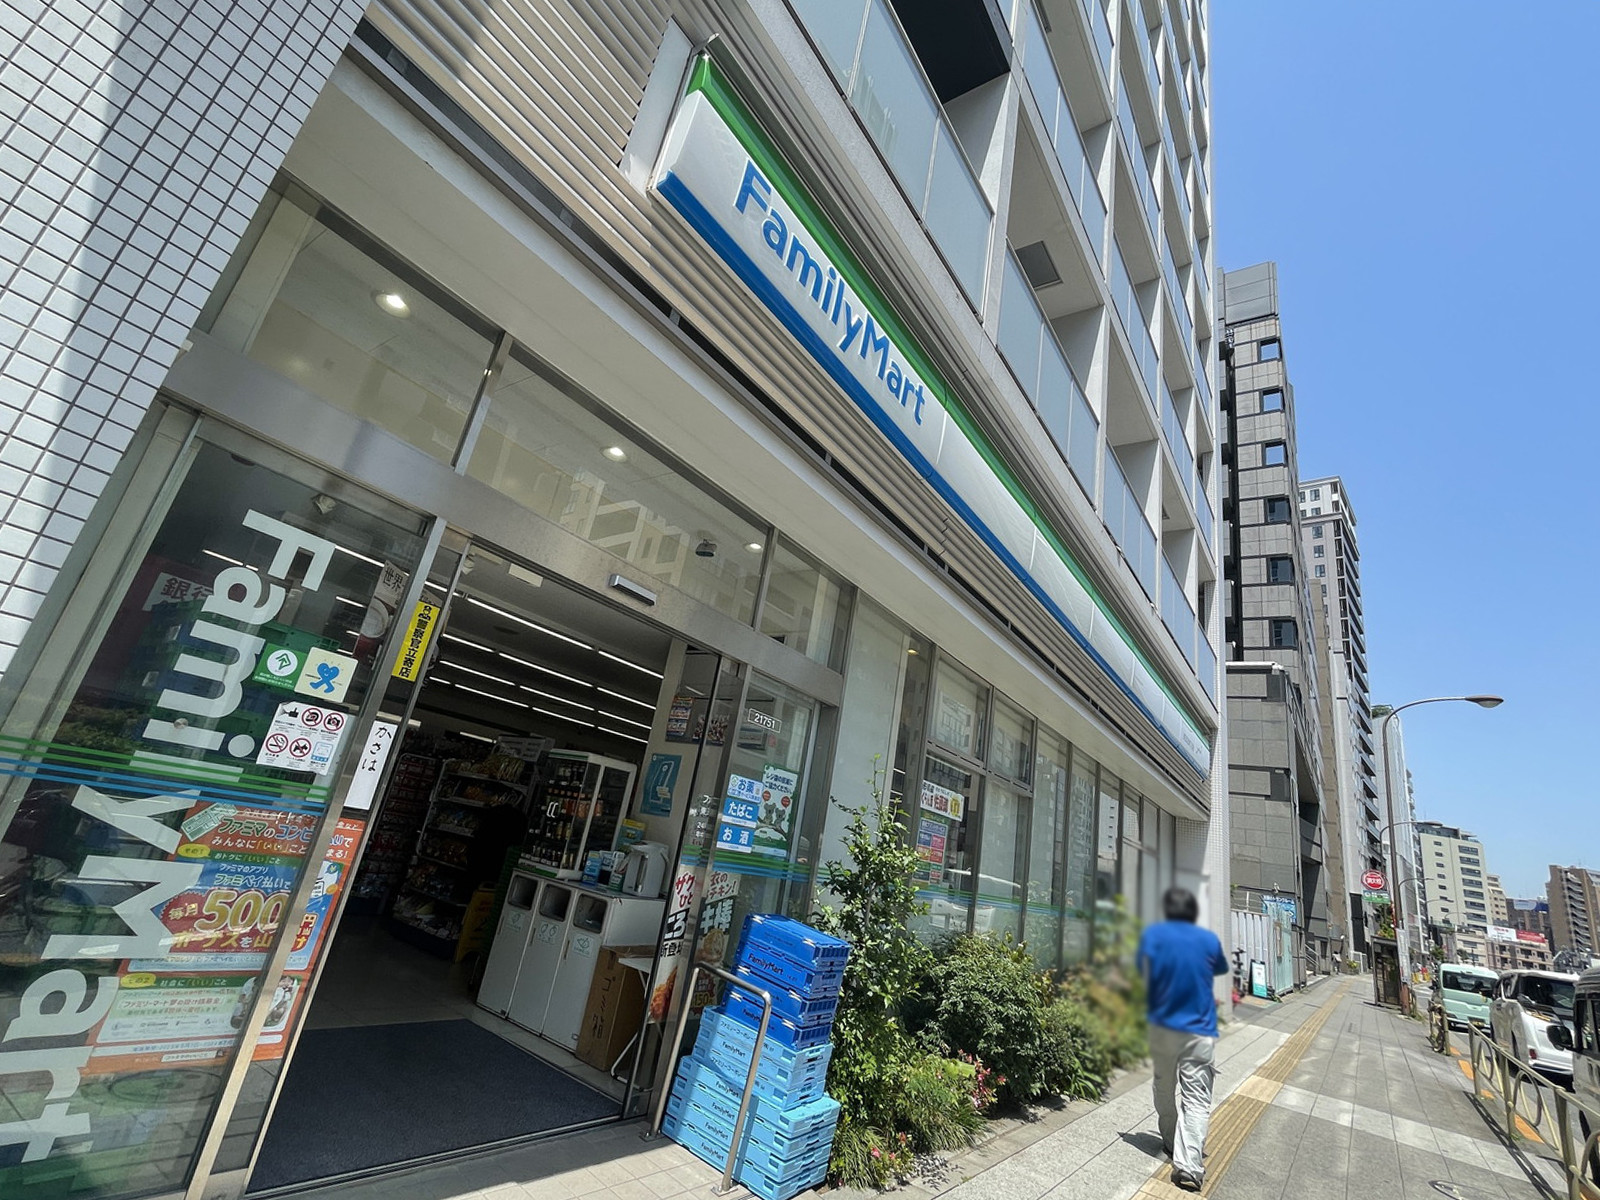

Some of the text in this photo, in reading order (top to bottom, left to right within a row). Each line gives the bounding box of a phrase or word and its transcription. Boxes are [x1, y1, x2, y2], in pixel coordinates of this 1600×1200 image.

[734, 159, 927, 427] FamilyMart
[399, 618, 429, 678] 警察官立寄店
[754, 713, 776, 728] 21751
[362, 727, 392, 772] かさは
[728, 801, 753, 819] たばこ
[0, 509, 336, 1164] FamilyMart
[723, 827, 750, 845] お酒
[748, 954, 784, 975] FamilyMart
[721, 1041, 746, 1058] FamilyMart
[716, 1081, 739, 1098] FamilyMart
[712, 1102, 735, 1119] FamilyMart
[705, 1121, 728, 1140] FamilyMart
[701, 1142, 724, 1161] FamilyMart
